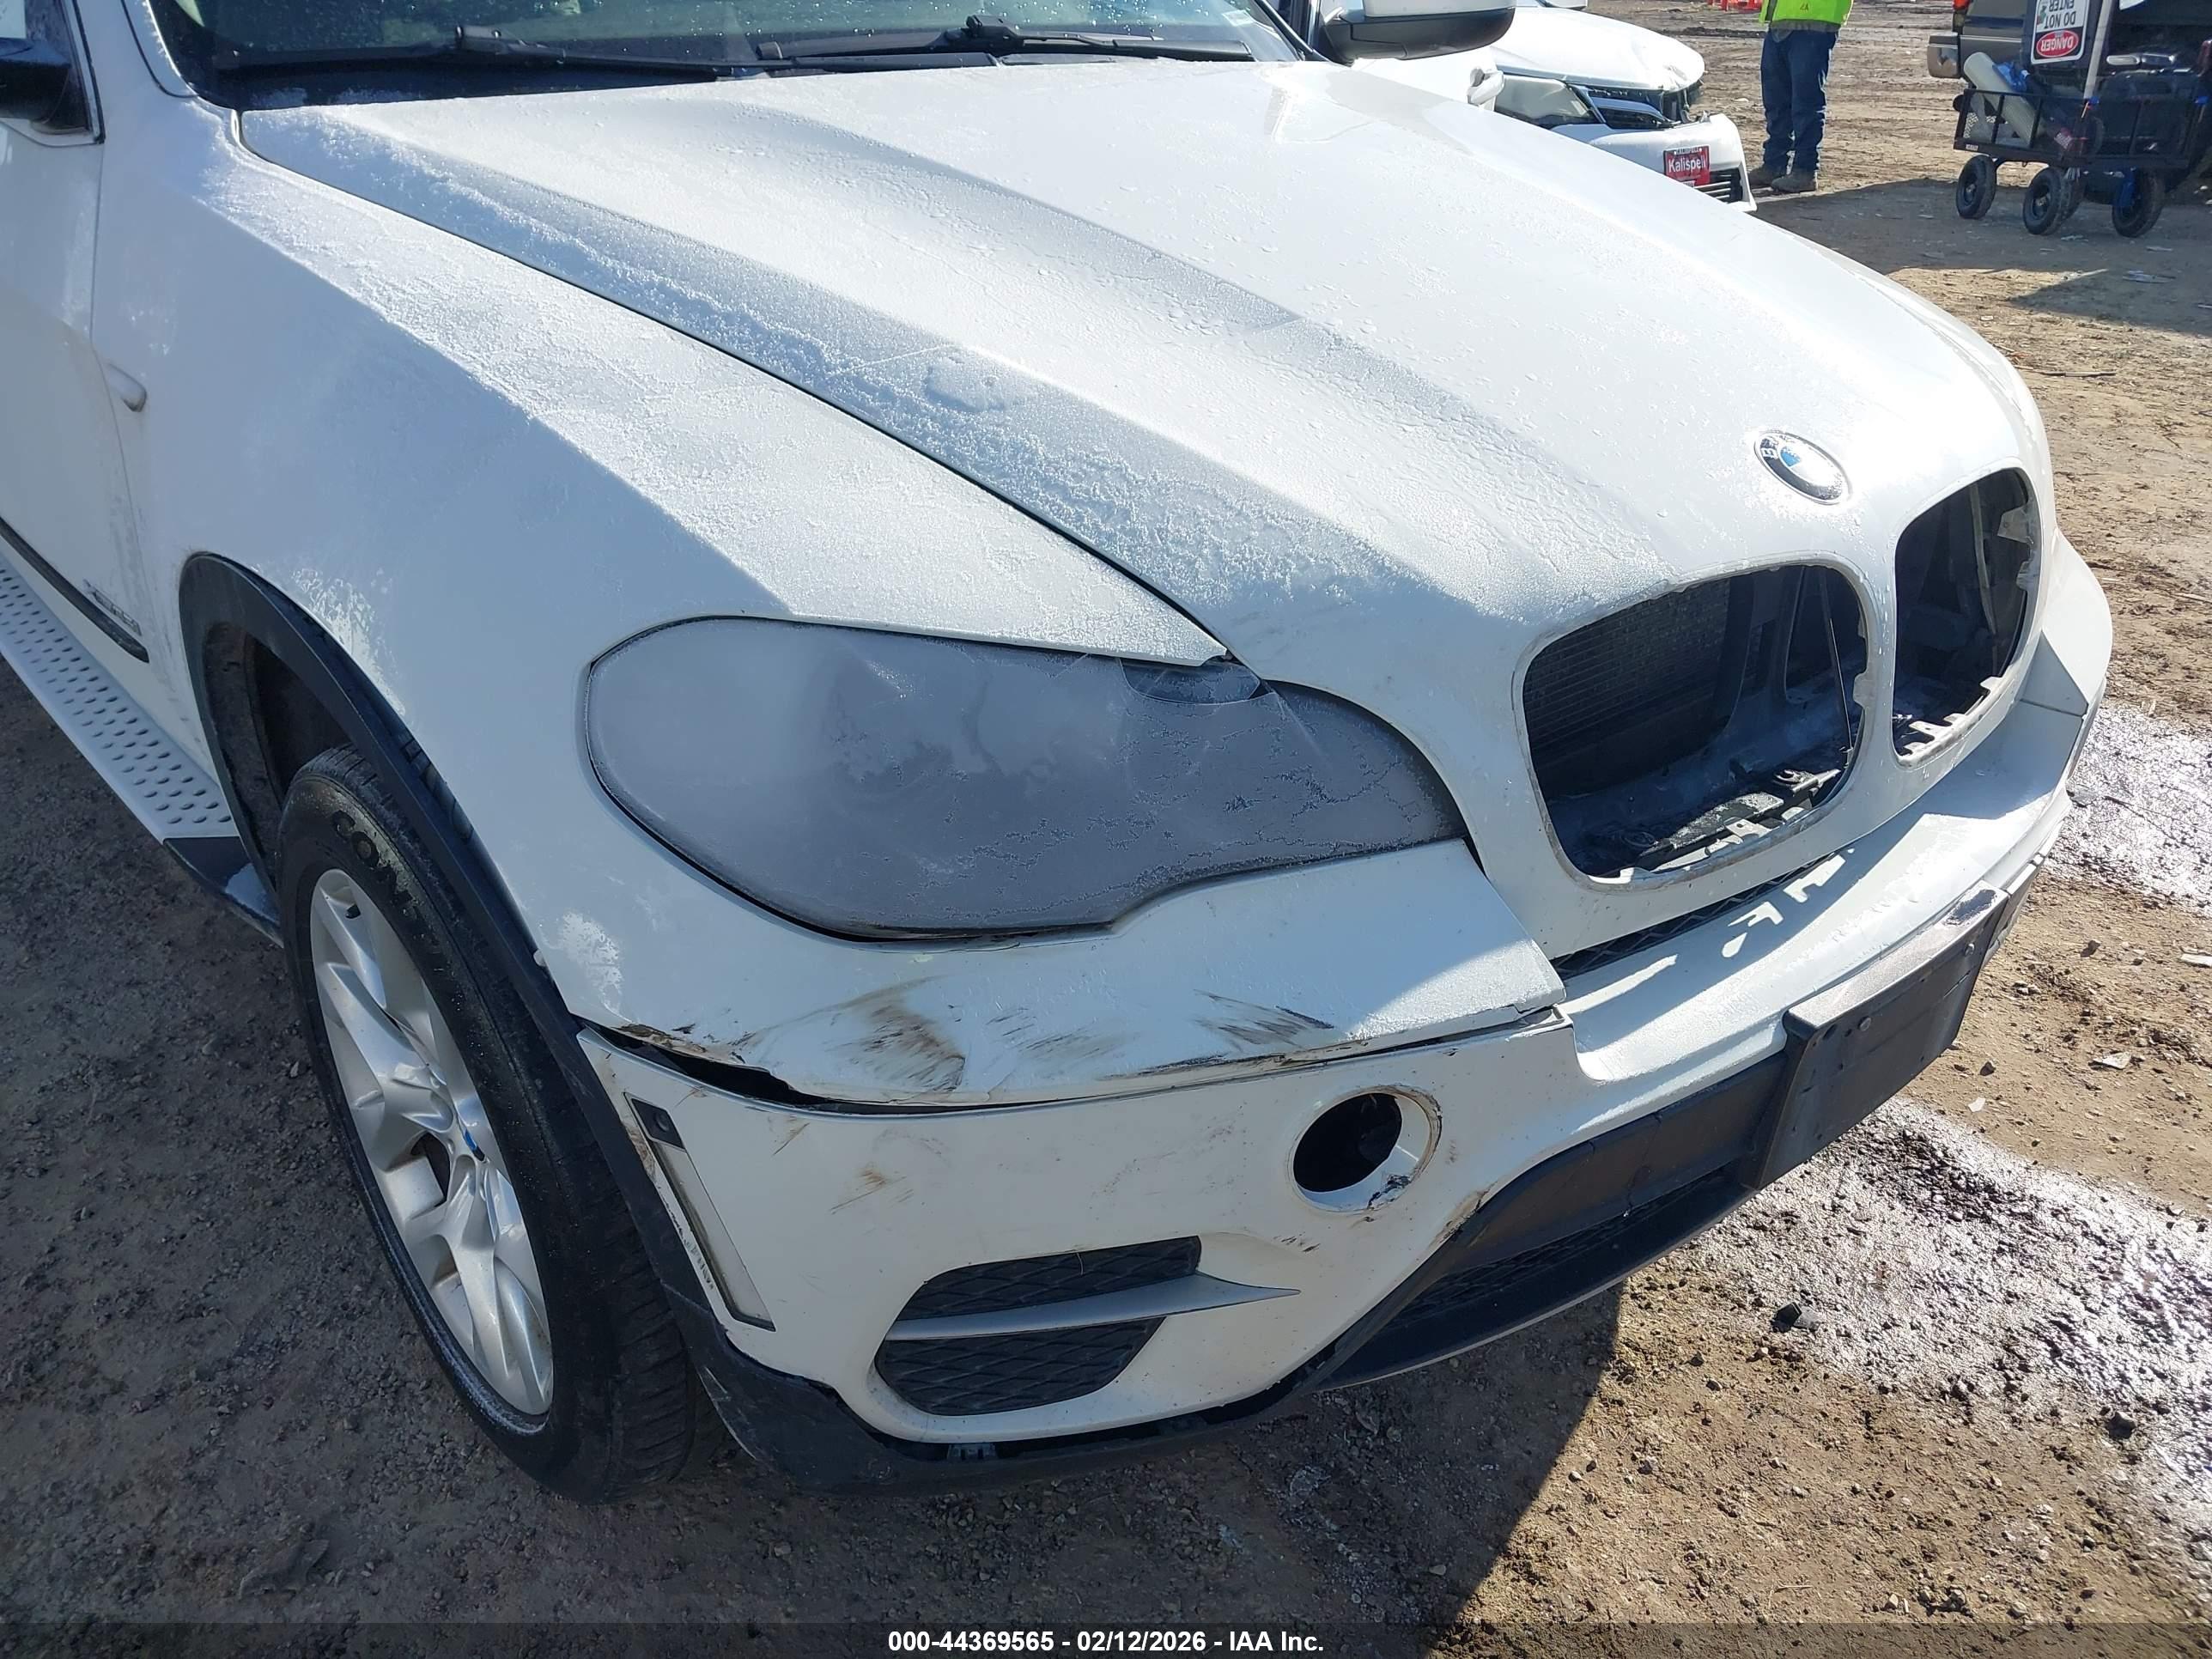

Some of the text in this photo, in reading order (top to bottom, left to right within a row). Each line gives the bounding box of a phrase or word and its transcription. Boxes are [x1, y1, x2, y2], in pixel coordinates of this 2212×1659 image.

[2049, 0, 2074, 12] ENTER
[2044, 11, 2076, 29] DO NOT
[2041, 36, 2074, 52] DANGER
[1668, 155, 1706, 173] Kalispell
